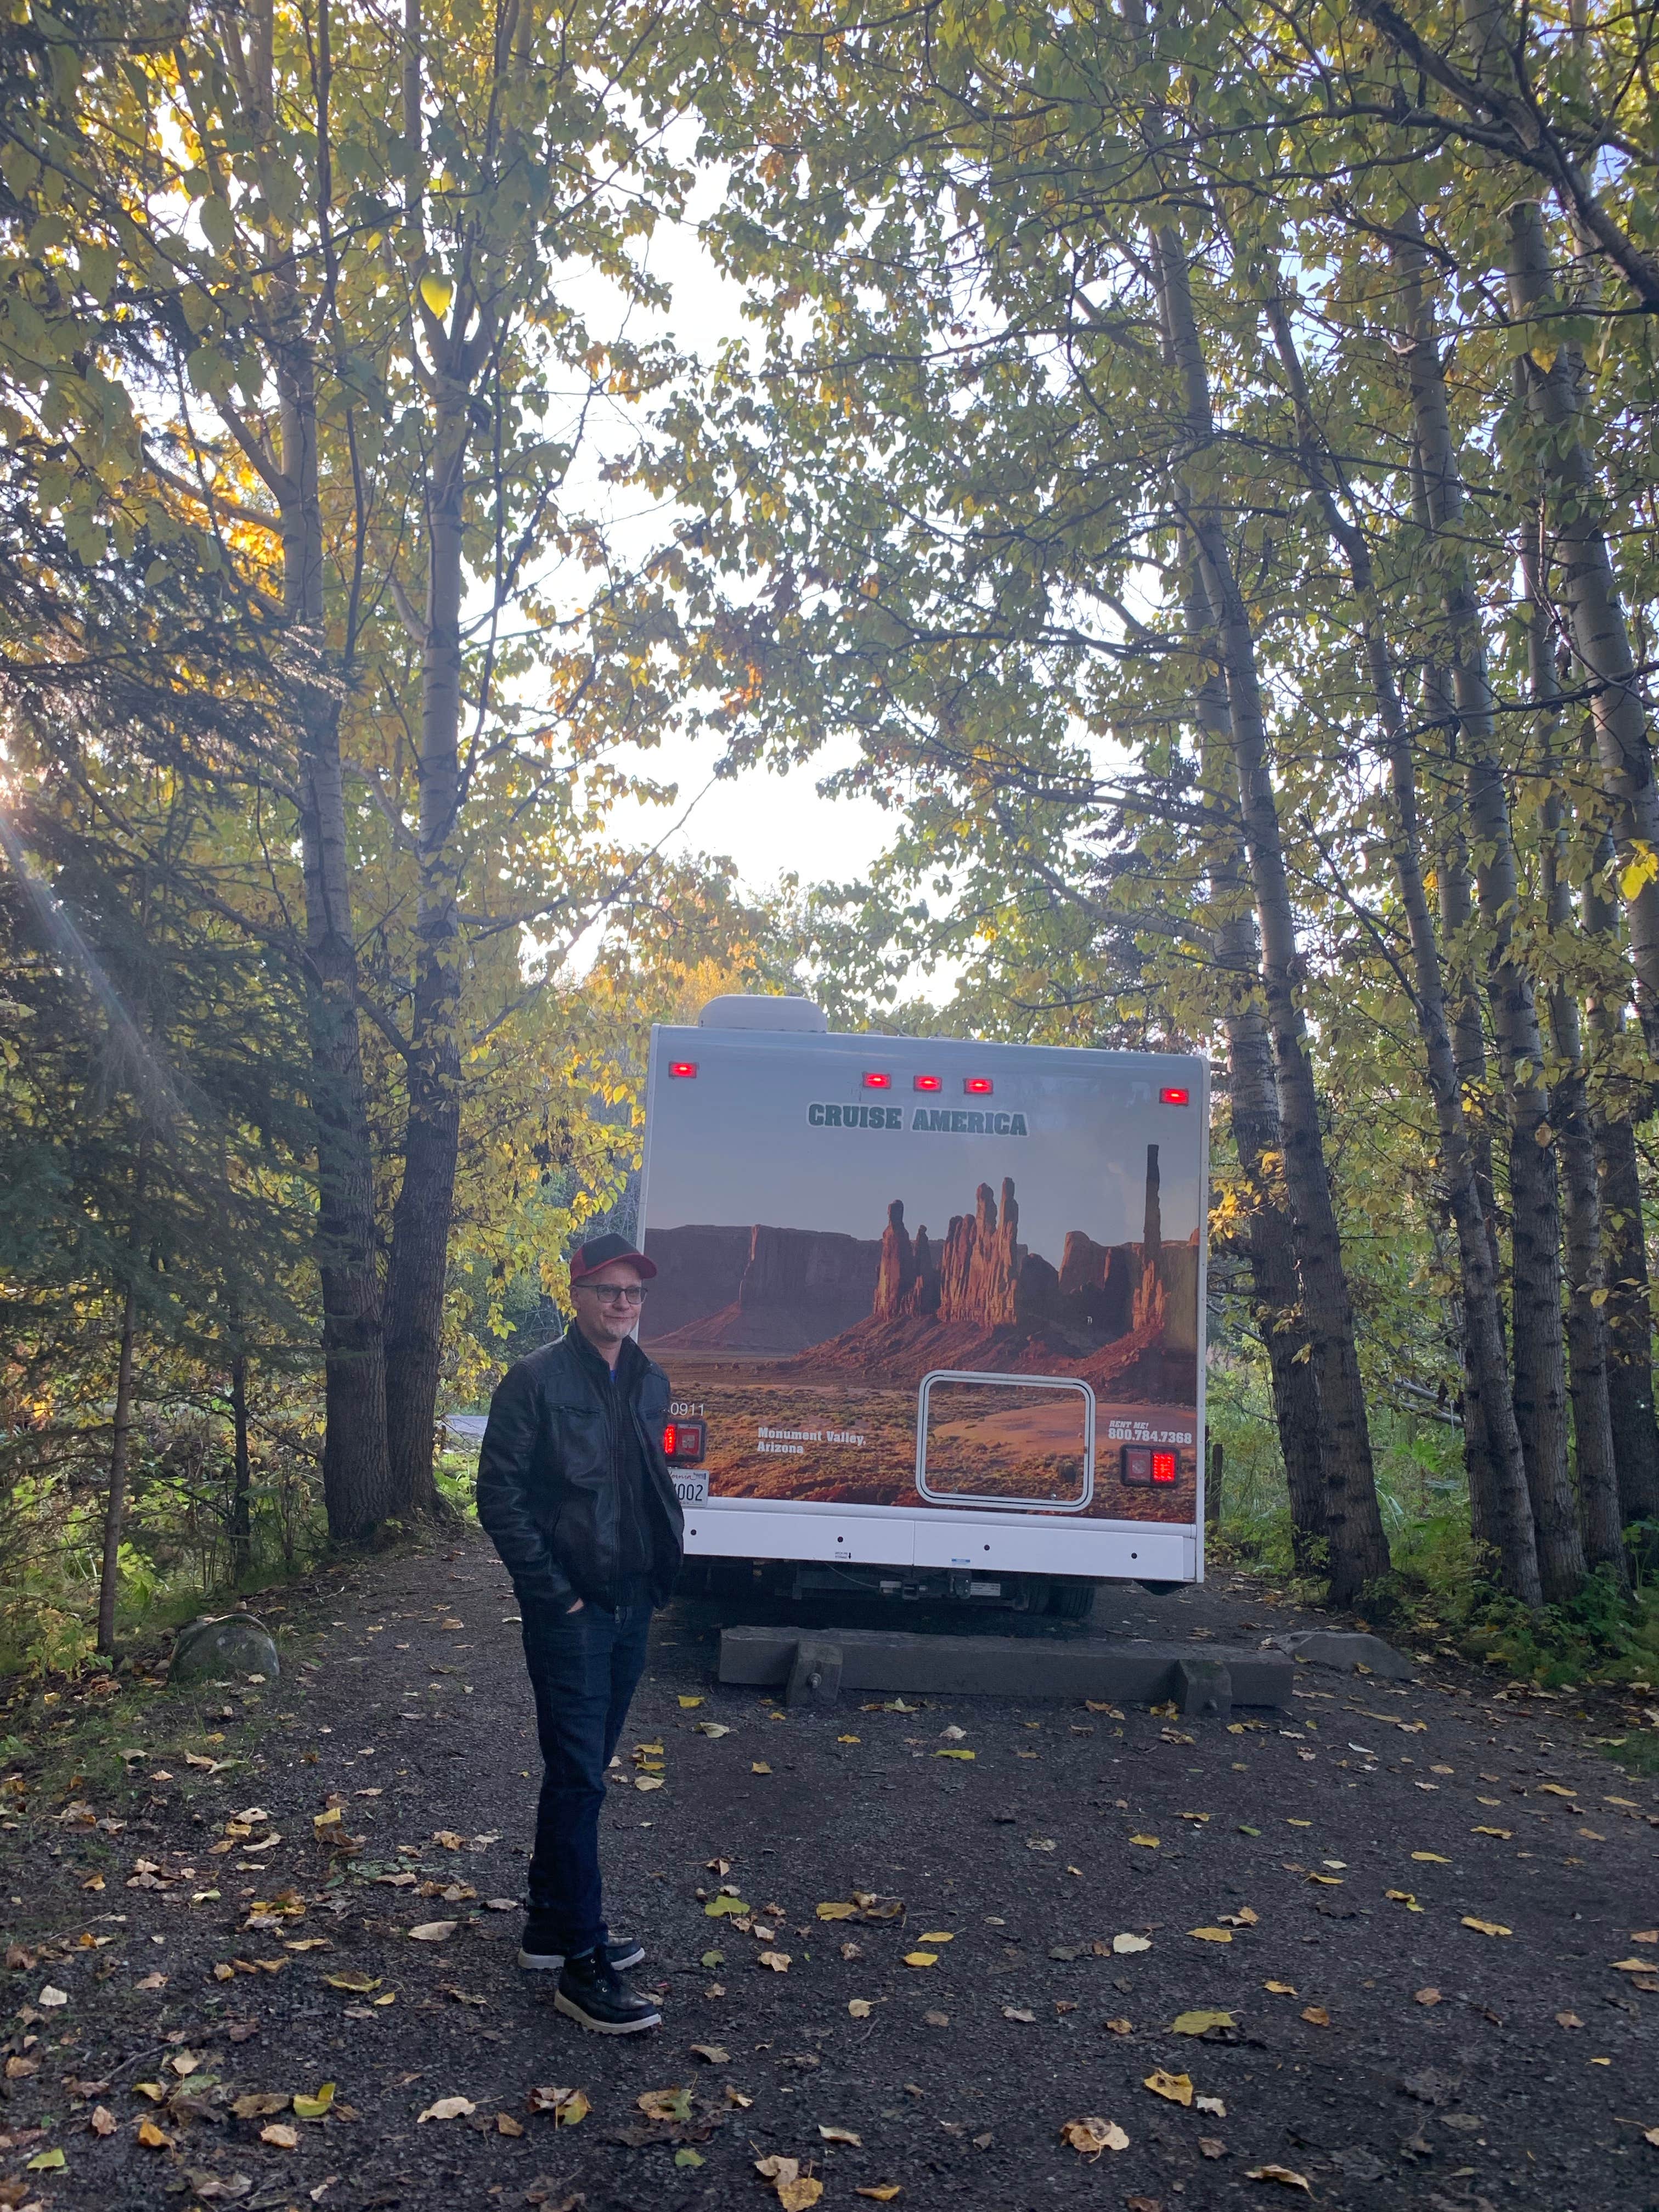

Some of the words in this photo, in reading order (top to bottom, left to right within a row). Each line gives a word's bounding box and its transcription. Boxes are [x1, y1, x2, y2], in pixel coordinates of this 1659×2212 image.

[808, 1103, 903, 1130] CRUISE
[911, 1108, 1029, 1136] AMERICA
[1133, 1421, 1149, 1430] ME!
[758, 1427, 822, 1441] Monument
[826, 1431, 867, 1446] Valley,
[1108, 1427, 1192, 1444] 800.784.7368
[757, 1441, 804, 1454] Arizona
